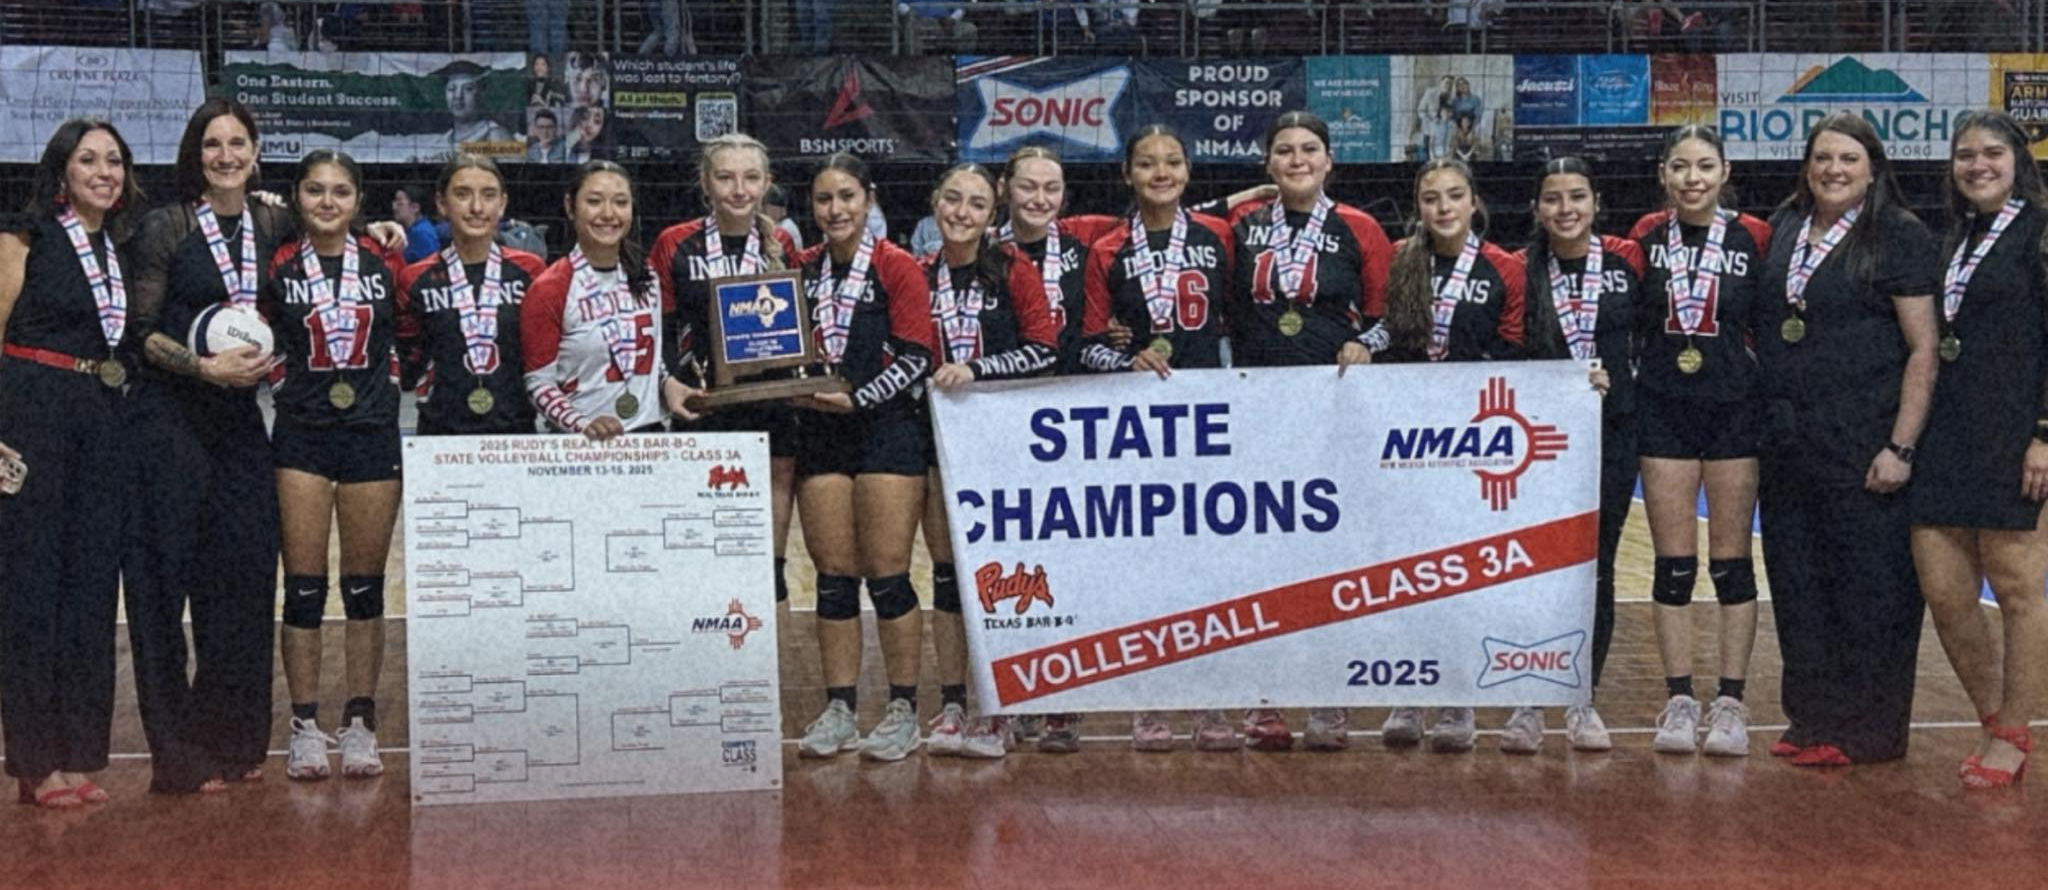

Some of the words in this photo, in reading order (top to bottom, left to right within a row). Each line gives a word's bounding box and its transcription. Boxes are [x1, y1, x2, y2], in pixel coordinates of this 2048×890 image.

[613, 60, 654, 71] Which
[657, 60, 715, 71] student's
[717, 60, 736, 71] life
[49, 70, 98, 81] CROWNE
[103, 70, 138, 81] PLAZA
[236, 74, 267, 88] One
[270, 74, 334, 89] Eastern.
[614, 74, 640, 83] was
[642, 73, 666, 83] lost
[669, 74, 681, 83] to
[684, 73, 742, 86] fentanyl?
[1187, 66, 1268, 83] PROUD
[236, 92, 267, 105] One
[271, 92, 334, 106] Student
[335, 92, 402, 107] Success.
[618, 93, 633, 103] All
[635, 93, 648, 103] of
[649, 93, 682, 103] them.
[1173, 89, 1281, 107] SPONSOR
[1720, 93, 1759, 103] VISIT
[987, 97, 1105, 127] SONIC
[1212, 114, 1242, 132] OF
[1720, 109, 1793, 141] RIO
[1194, 140, 1262, 157] NMAA
[1029, 403, 1232, 463] STATE
[480, 440, 508, 451] 2025
[511, 439, 558, 450] RUDY'S
[562, 438, 594, 450] REAL
[599, 438, 640, 449] TEXAS
[643, 437, 697, 449] BAR-B-Q
[1381, 426, 1514, 460] NMAA
[434, 453, 474, 465] STATE
[477, 452, 561, 464] VOLLEYBALL
[564, 450, 670, 463] CHAMPIONSHIPS
[680, 450, 722, 461] CLASS
[726, 450, 741, 461] 3A
[527, 466, 592, 476] NOVEMBER
[628, 465, 654, 475] 2025
[956, 478, 1341, 544] CHAMPIONS
[974, 561, 1055, 614] Rudy's
[692, 617, 743, 631] NMAA
[984, 617, 1022, 631] TEXAS
[1011, 600, 1280, 693] VOLLEYBALL
[1331, 553, 1469, 612] CLASS
[1478, 539, 1534, 578] 3A
[1491, 651, 1572, 671] SONIC
[1347, 660, 1440, 687] 2025
[722, 748, 757, 763] CLASS
